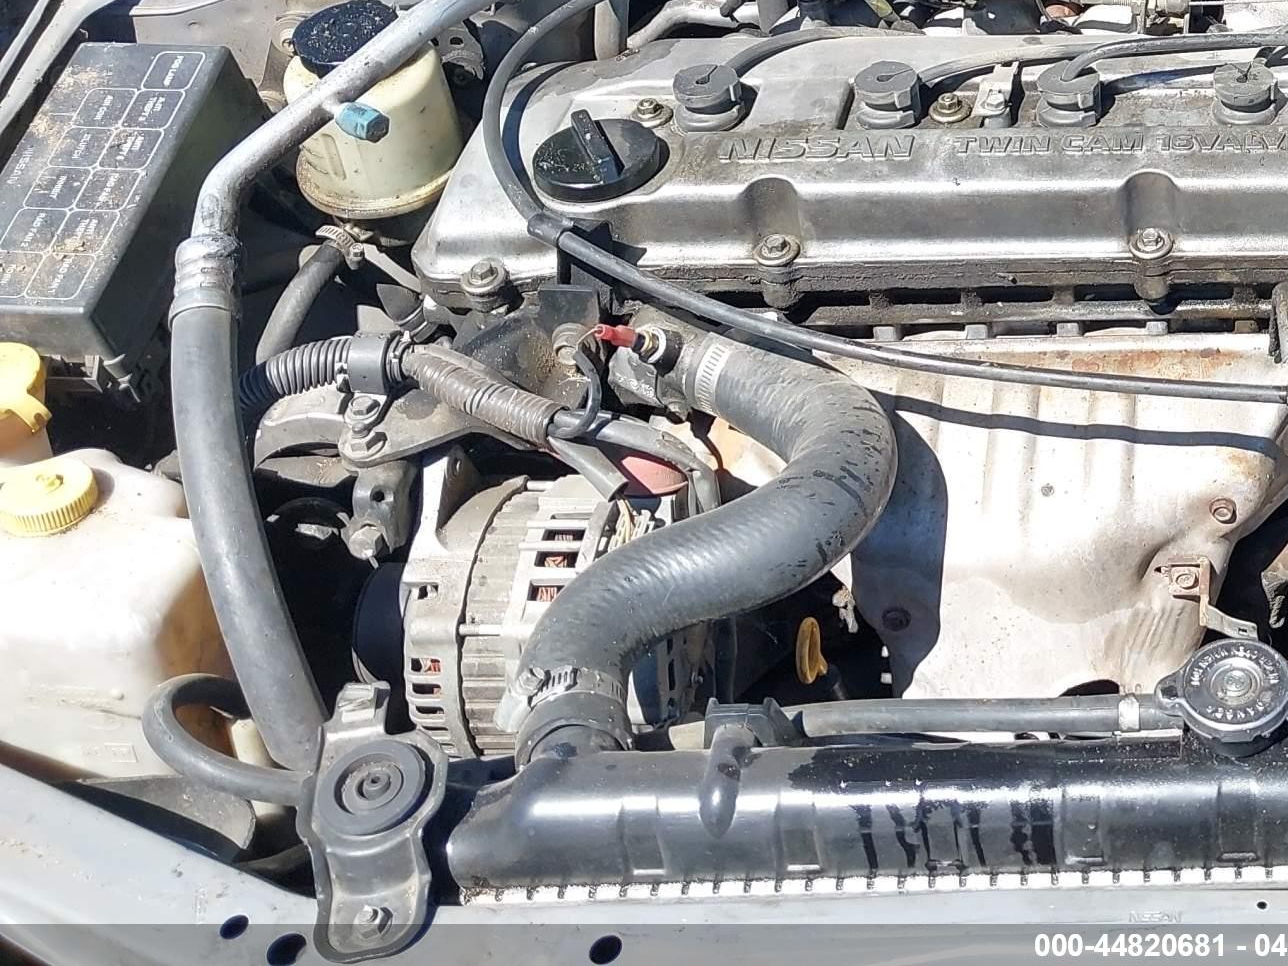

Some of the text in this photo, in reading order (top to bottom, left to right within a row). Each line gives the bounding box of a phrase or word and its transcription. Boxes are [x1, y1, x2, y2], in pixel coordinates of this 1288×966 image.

[720, 135, 916, 164] NISSAN
[953, 135, 1051, 155] TWIN
[1062, 134, 1144, 154] CAM
